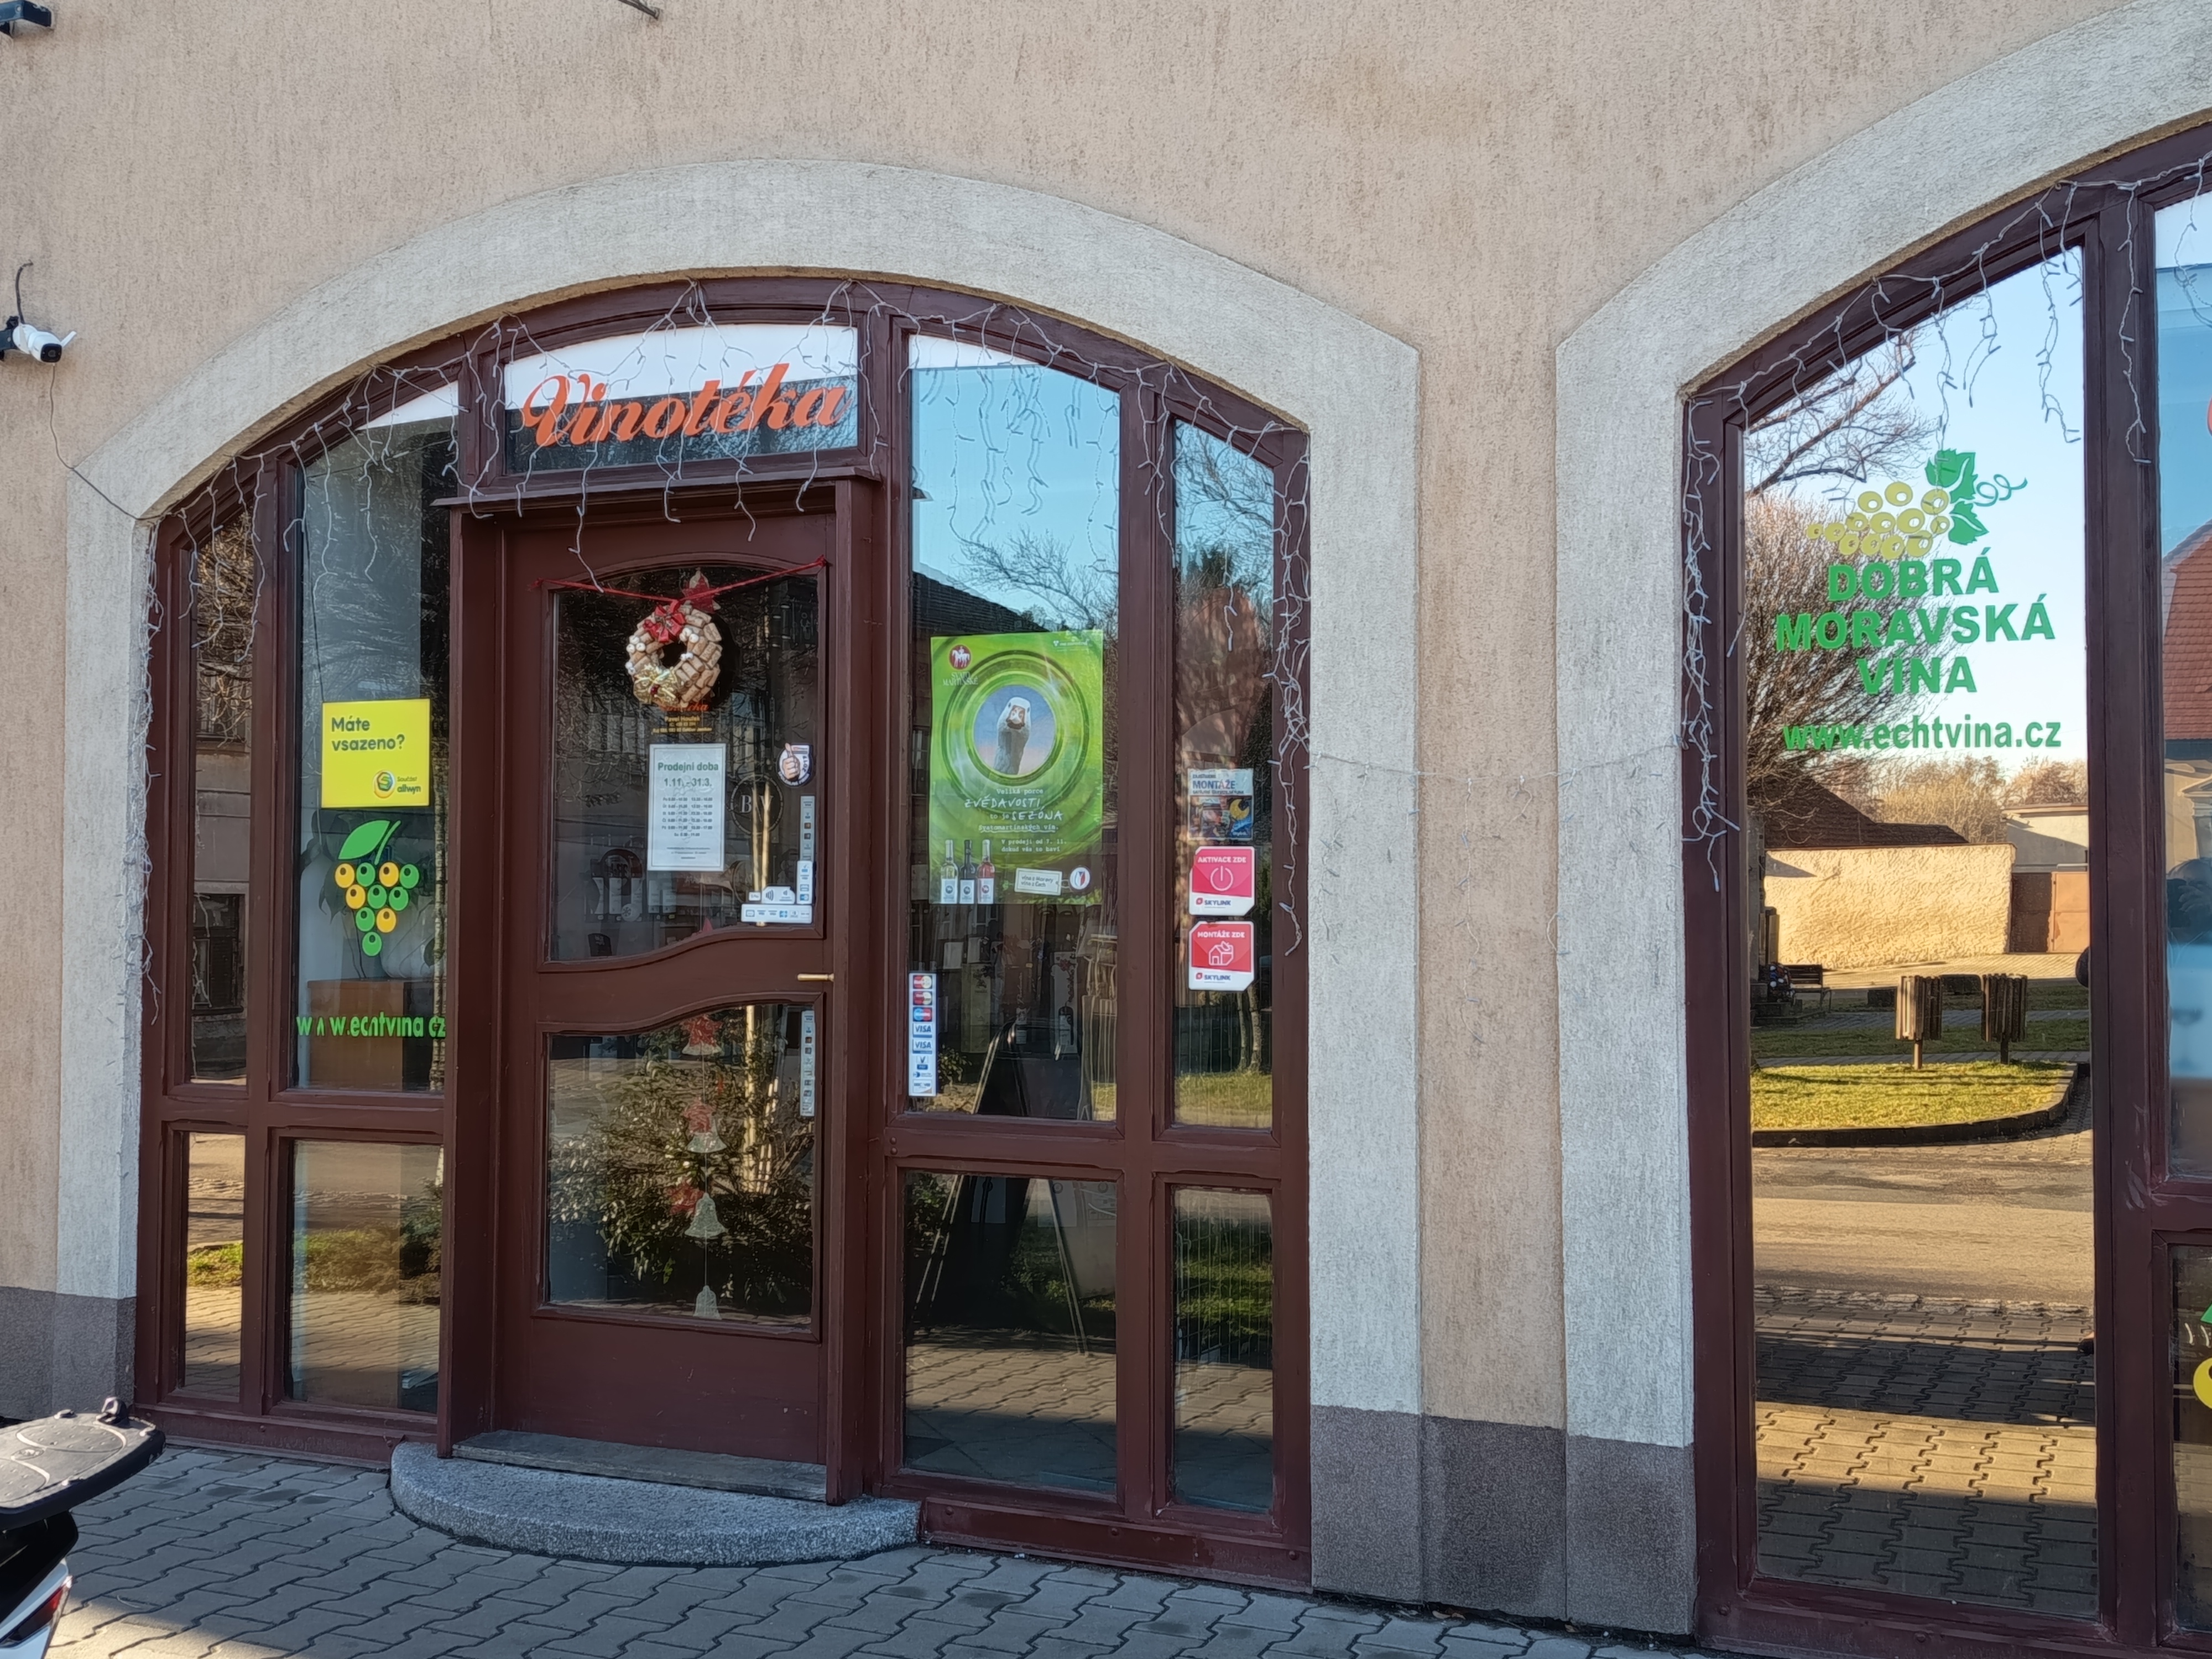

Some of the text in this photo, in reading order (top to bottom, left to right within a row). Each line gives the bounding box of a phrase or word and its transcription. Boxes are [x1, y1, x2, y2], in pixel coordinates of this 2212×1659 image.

[523, 363, 853, 446] Vinotéka
[1828, 547, 1999, 601] DOBRÁ
[1776, 593, 2056, 651] MORAVSKÁ
[1856, 649, 1977, 695] VÍNA
[331, 716, 371, 732] Máte
[1783, 714, 2062, 750] www.echtvina.cz
[331, 734, 405, 751] vsazeno?
[658, 762, 719, 773] Prodejní doba
[397, 784, 421, 795] allwyn
[1192, 779, 1236, 789] MONTÁŽE
[1197, 930, 1230, 938] MONTÁŽE
[296, 1011, 446, 1037] ww.echtvinacz
